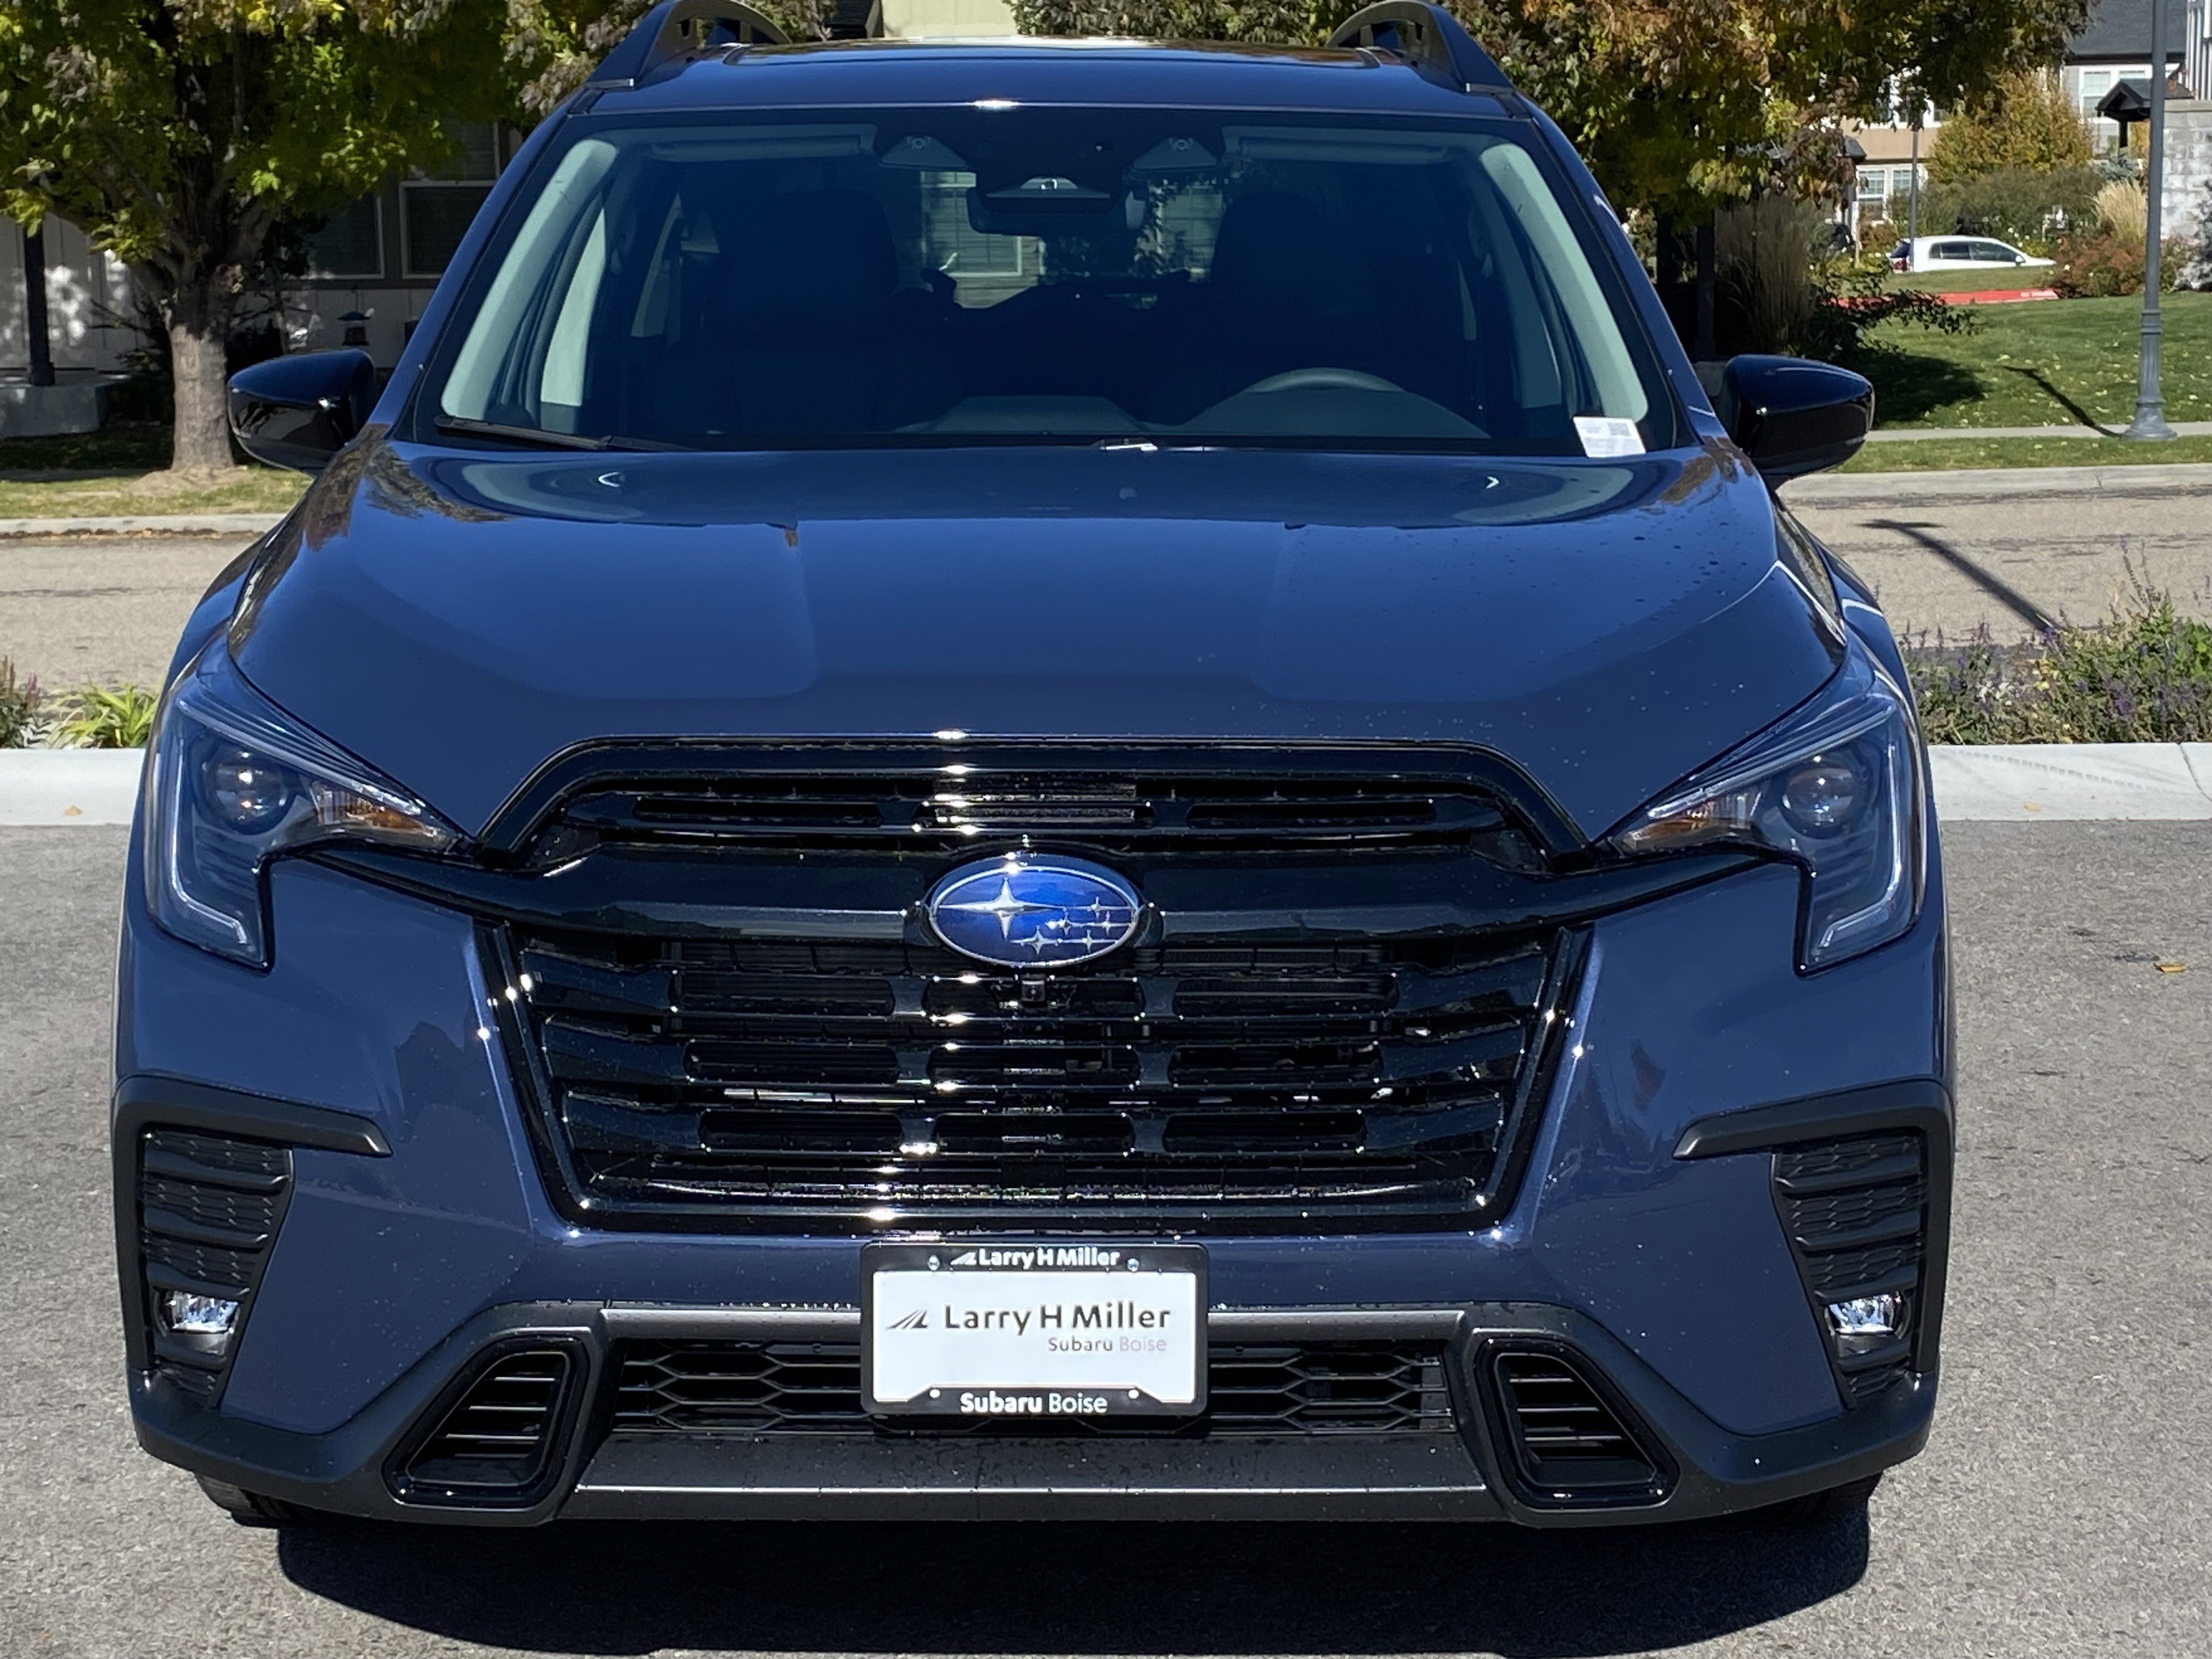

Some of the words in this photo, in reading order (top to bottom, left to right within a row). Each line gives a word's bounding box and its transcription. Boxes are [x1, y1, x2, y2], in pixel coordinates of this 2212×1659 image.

[979, 1248, 1035, 1270] Larry
[1037, 1248, 1054, 1266] H
[1057, 1247, 1121, 1266] Miller
[944, 1305, 1031, 1336] Larry
[1041, 1305, 1062, 1328] H
[1073, 1301, 1171, 1328] Miller
[1048, 1336, 1113, 1352] Subaru
[1119, 1336, 1167, 1352] Boise
[960, 1391, 1042, 1413] Subaru
[1049, 1392, 1108, 1413] Boise
